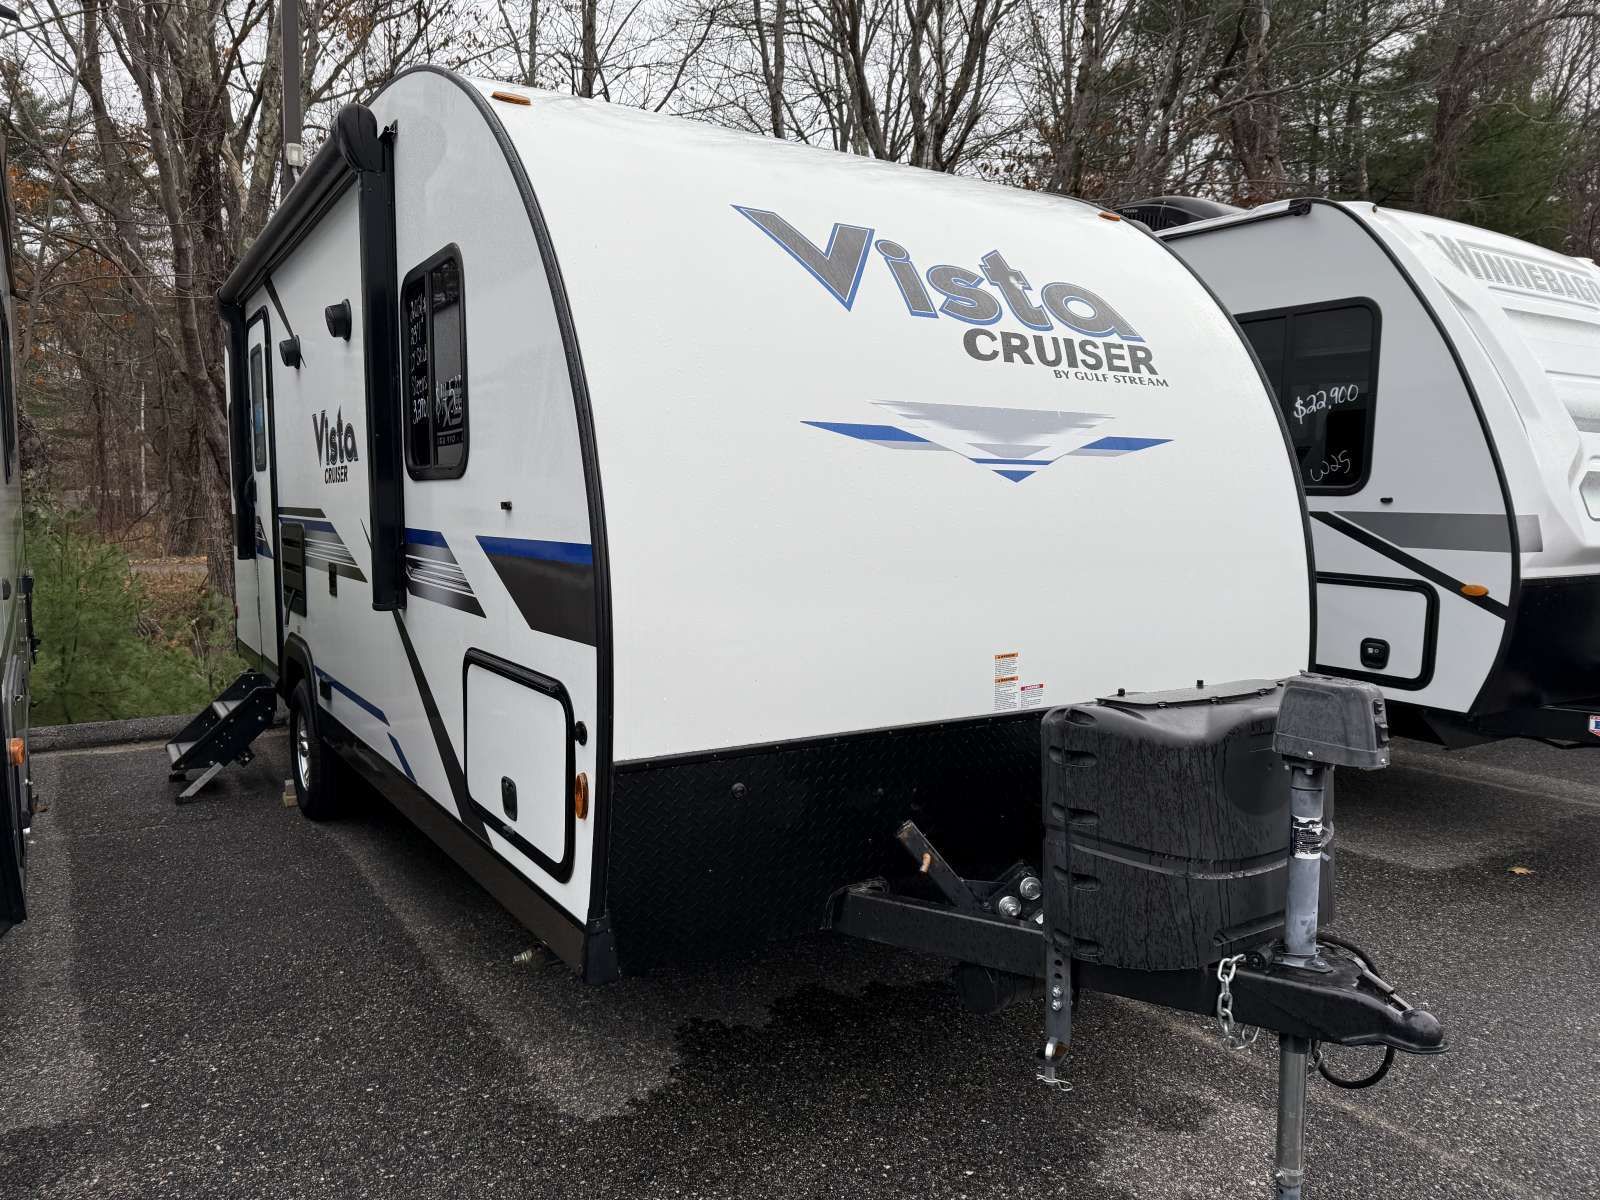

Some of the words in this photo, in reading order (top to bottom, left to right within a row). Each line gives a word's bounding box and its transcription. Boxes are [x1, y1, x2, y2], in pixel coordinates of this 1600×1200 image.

[730, 204, 1146, 343] Vista
[962, 328, 1159, 376] CRUISER
[1053, 369, 1070, 380] BY
[1074, 371, 1109, 383] GULF
[1114, 374, 1170, 388] STREAM
[312, 404, 359, 469] Vista
[324, 464, 349, 485] CRUISER
